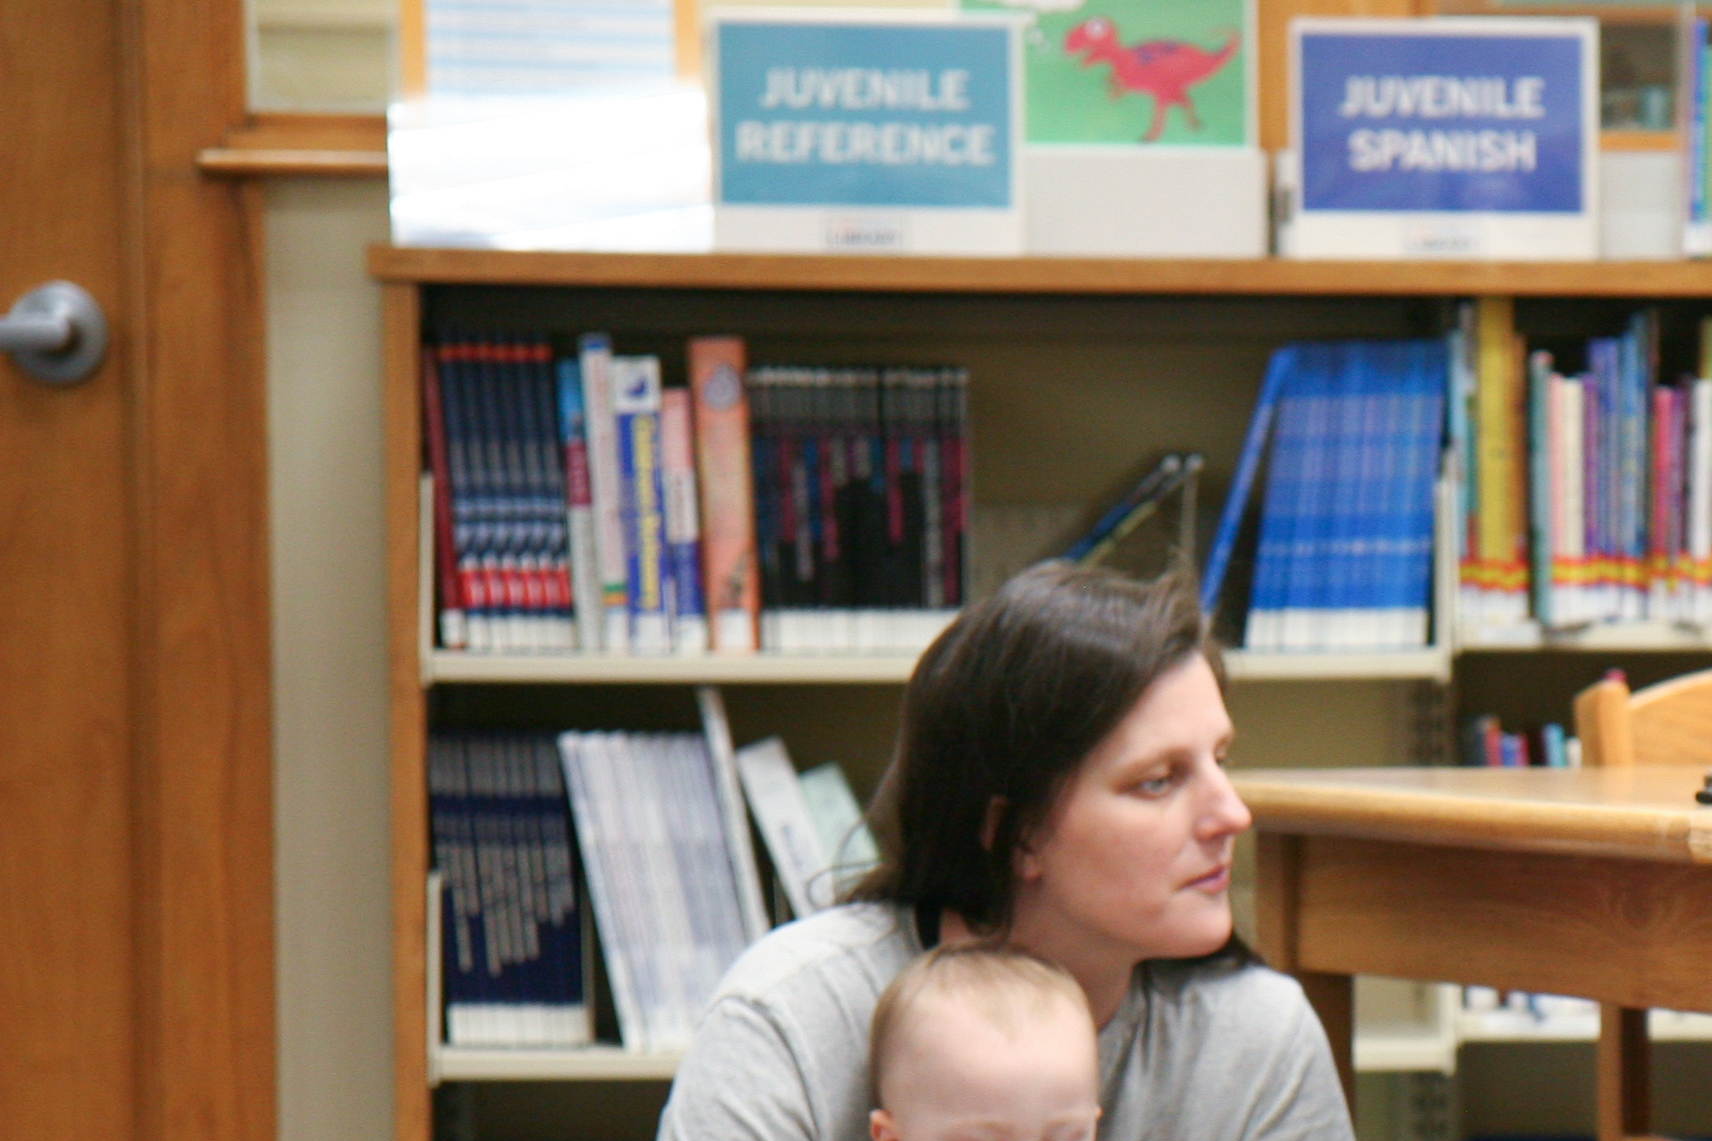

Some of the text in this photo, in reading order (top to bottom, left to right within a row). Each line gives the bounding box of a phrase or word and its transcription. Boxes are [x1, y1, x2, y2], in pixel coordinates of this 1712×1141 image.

[759, 67, 969, 110] JUVENILE
[1337, 74, 1547, 119] JUVENILE
[734, 121, 996, 166] REFERENCE
[1346, 128, 1538, 173] SPANISH
